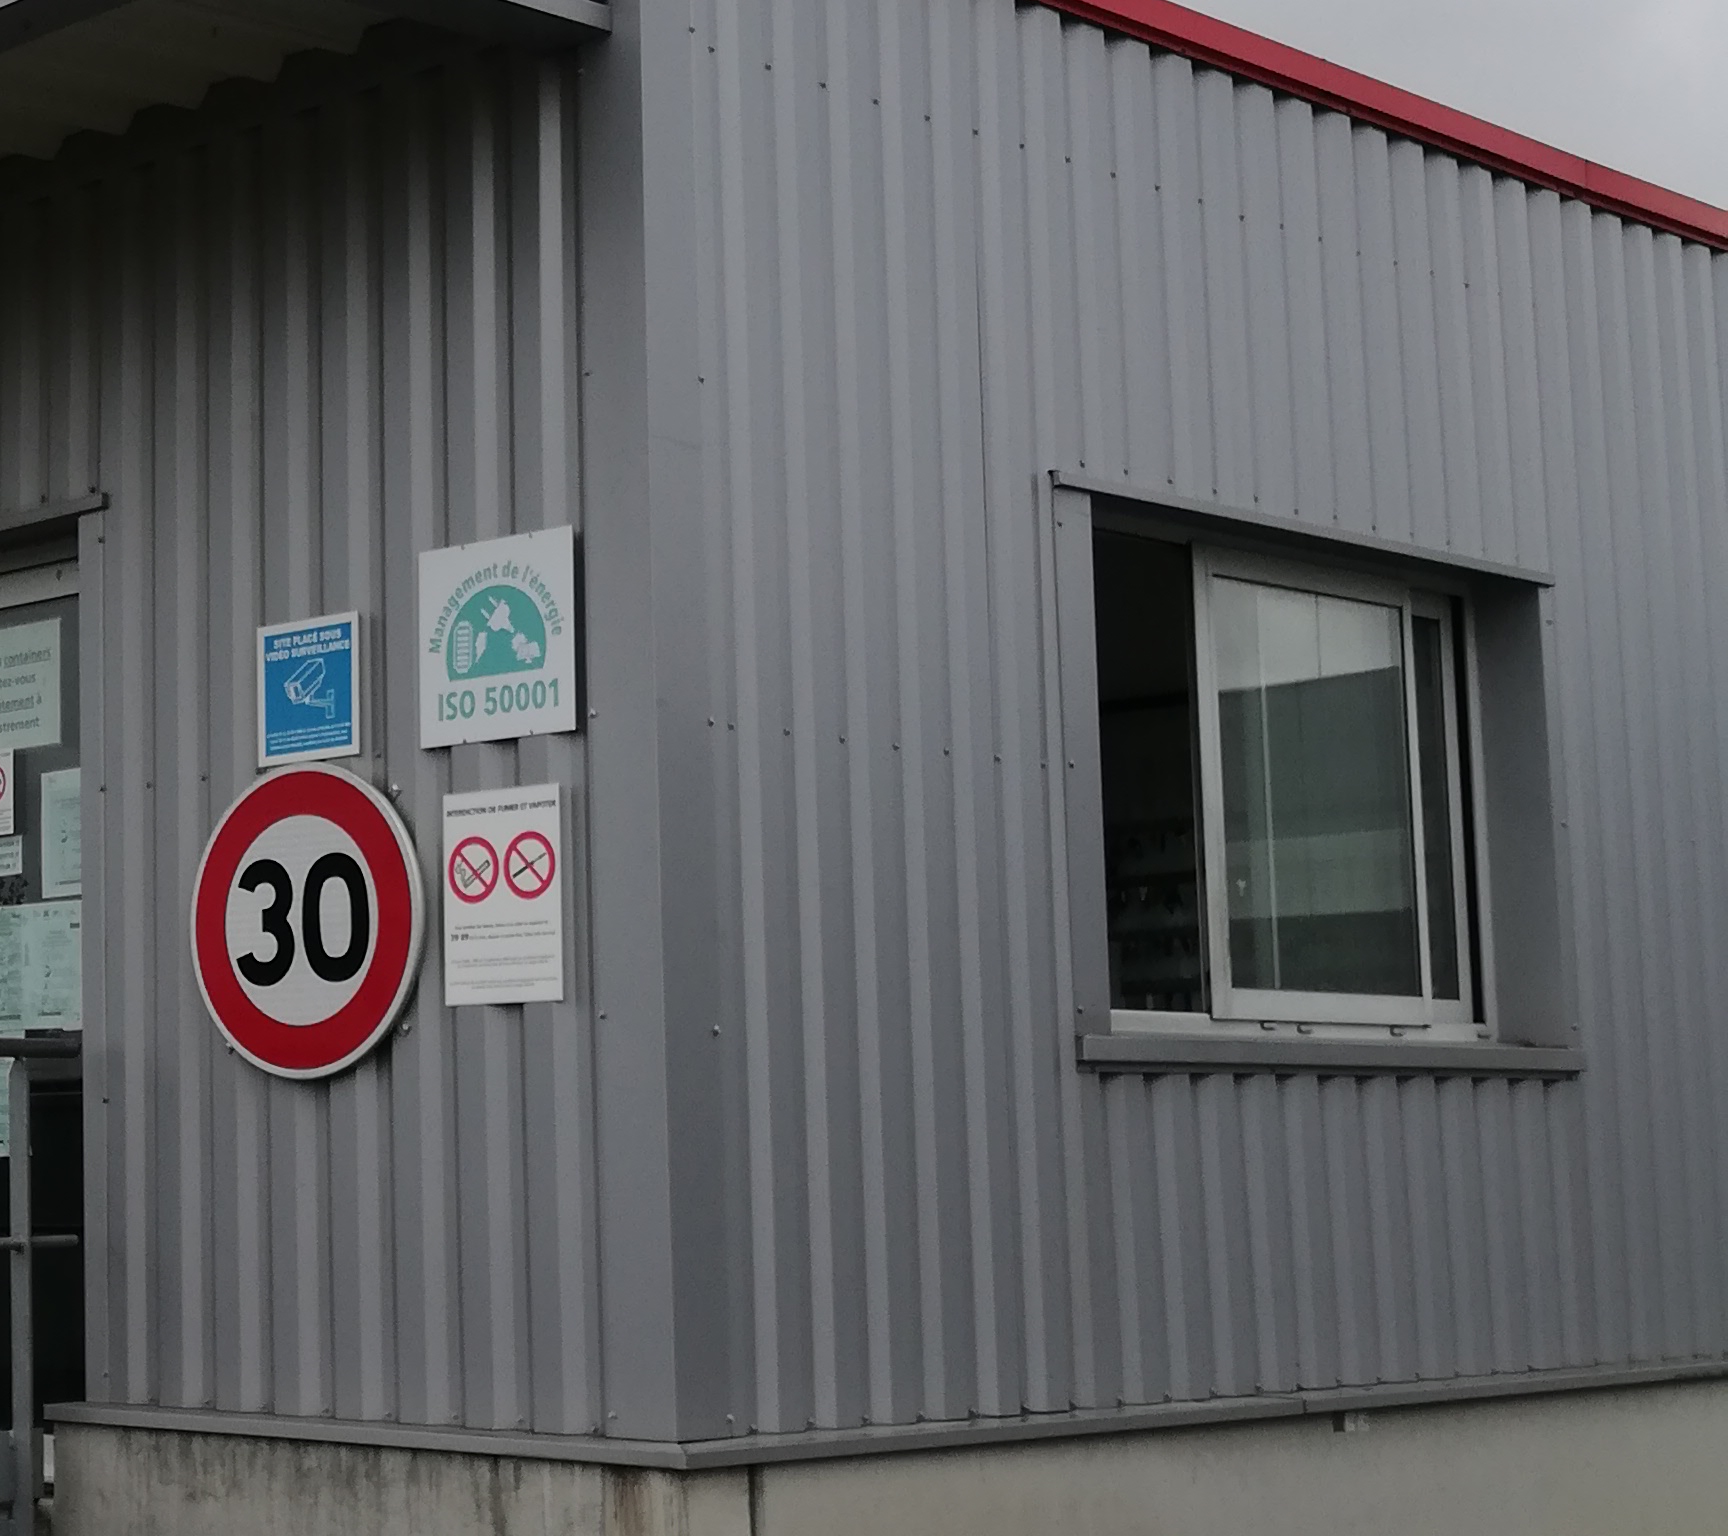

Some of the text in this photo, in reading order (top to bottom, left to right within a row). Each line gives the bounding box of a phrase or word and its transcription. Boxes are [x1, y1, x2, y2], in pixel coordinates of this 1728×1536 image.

[428, 560, 565, 654] Management de l'énergie
[273, 627, 342, 650] SITE PLACÉ SOUS
[291, 639, 351, 658] SURVEILLANCE
[3, 646, 52, 667] containers
[35, 692, 43, 705] à
[437, 677, 560, 722] ISO 50001
[235, 851, 370, 987] 30
